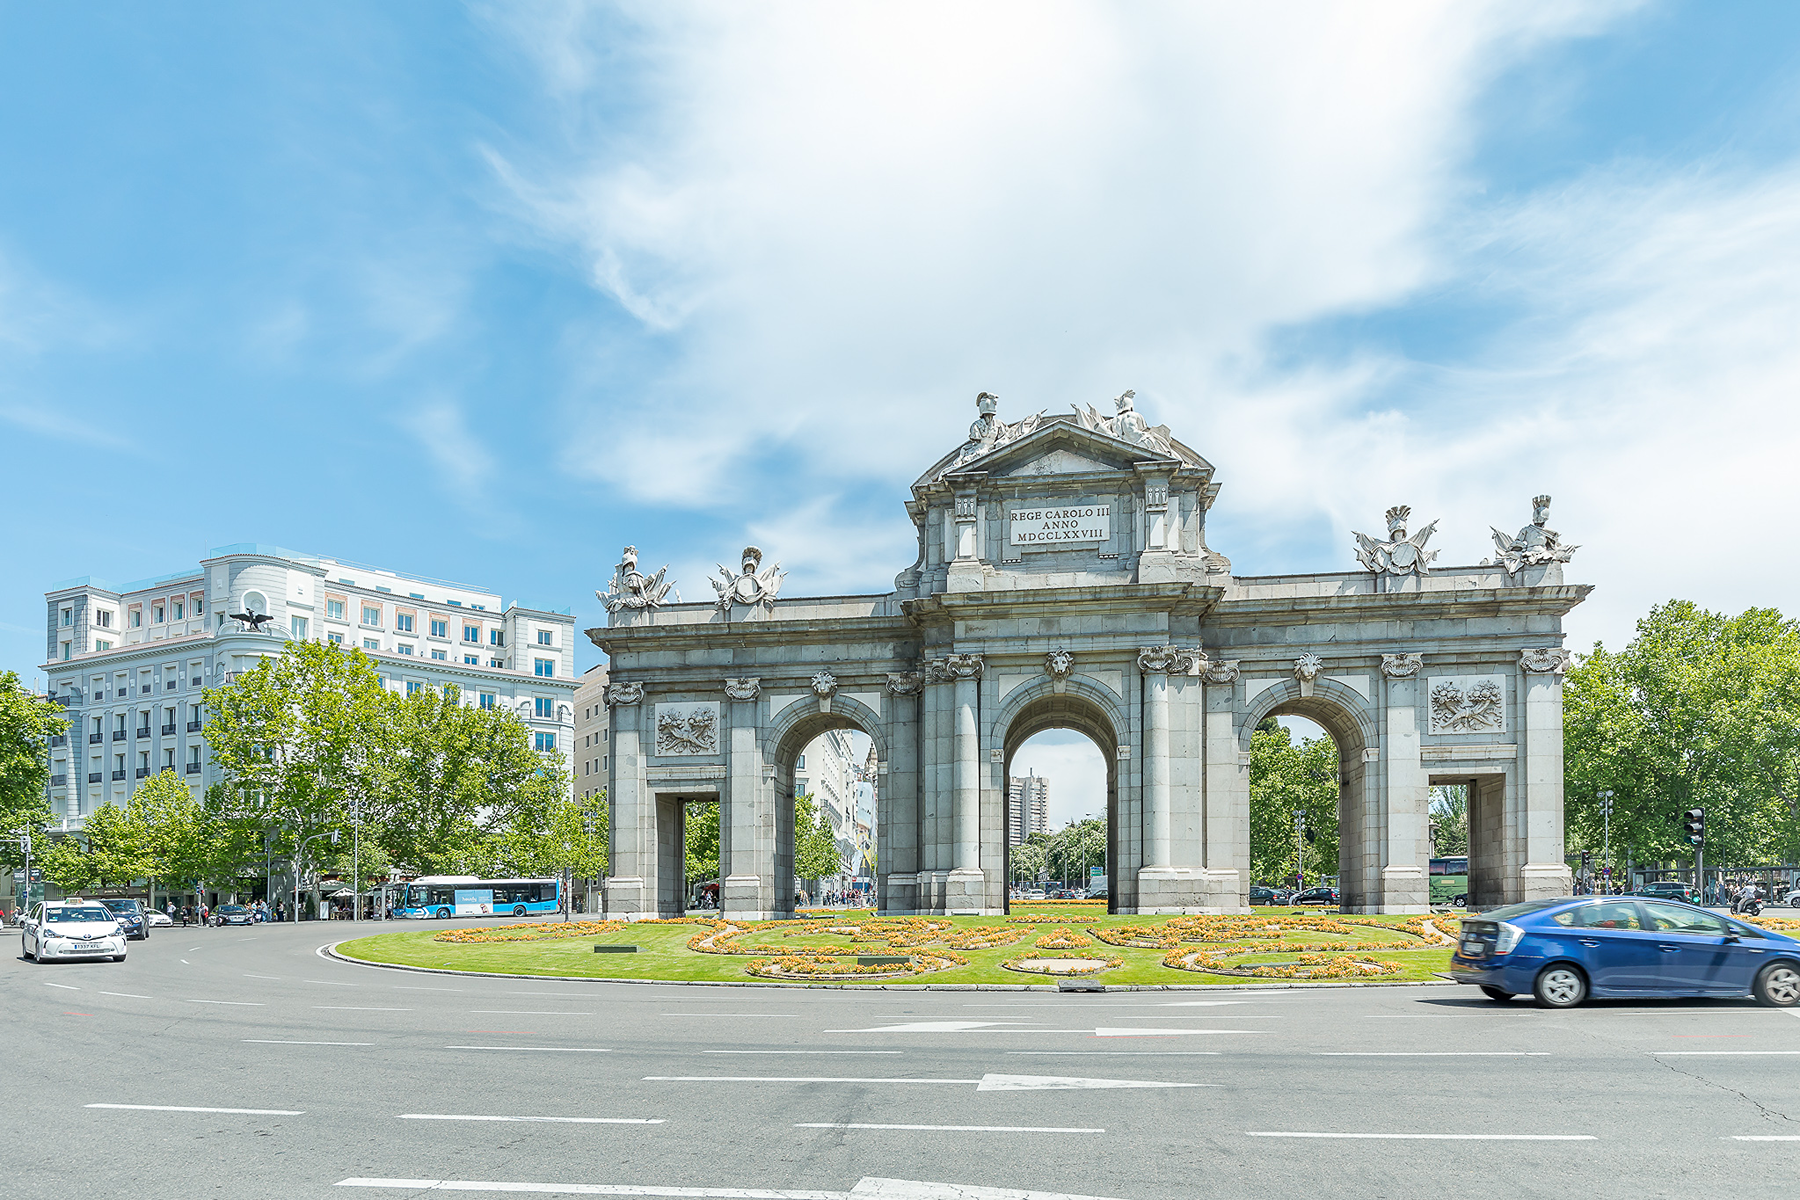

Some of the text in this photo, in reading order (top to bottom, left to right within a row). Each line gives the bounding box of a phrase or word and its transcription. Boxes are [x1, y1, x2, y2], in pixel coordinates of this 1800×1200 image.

[1011, 508, 1110, 521] REGE CAROLO III
[1042, 520, 1078, 530] ANNO
[1017, 529, 1103, 541] MDCCLXXVIII
